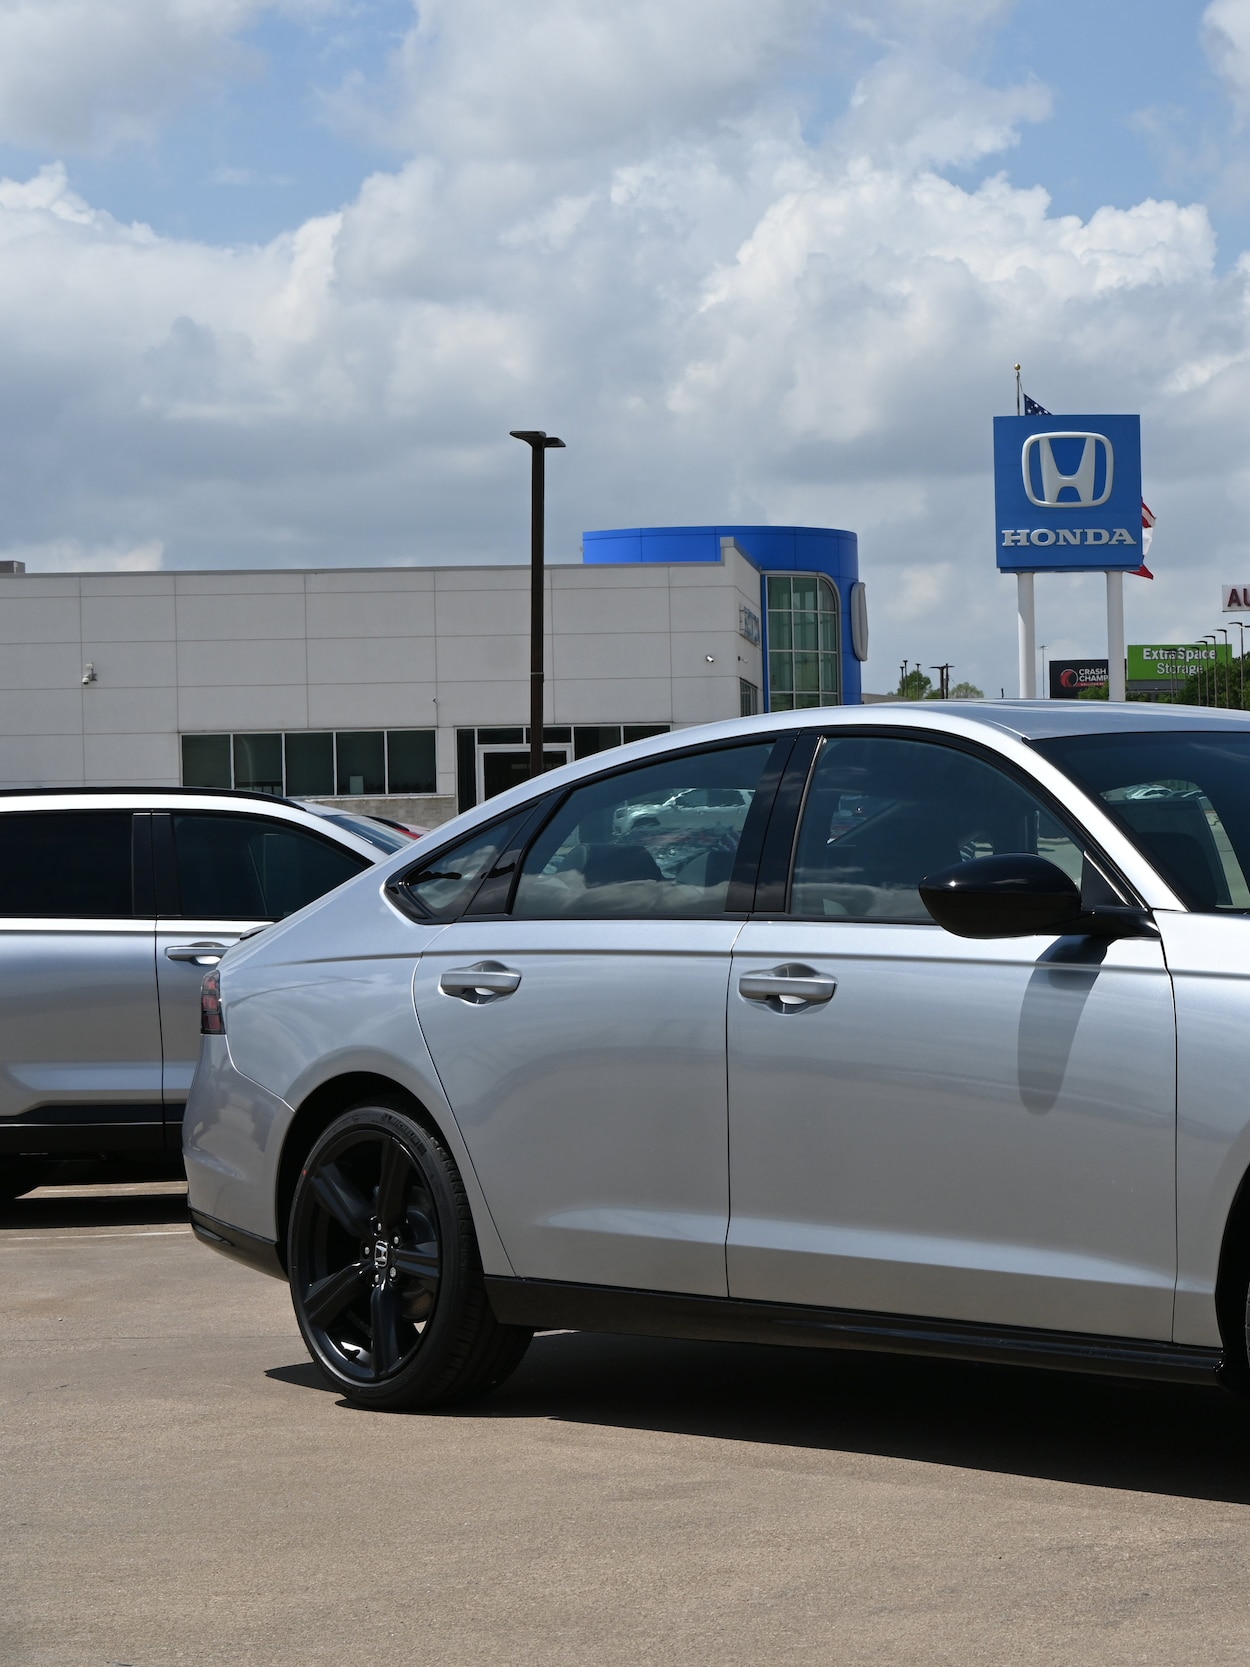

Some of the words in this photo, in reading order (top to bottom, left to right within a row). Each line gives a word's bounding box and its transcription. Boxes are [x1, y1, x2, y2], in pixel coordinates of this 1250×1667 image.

[1001, 528, 1137, 547] HONDA
[1079, 668, 1107, 676] CRASH
[1157, 662, 1204, 676] Storage
